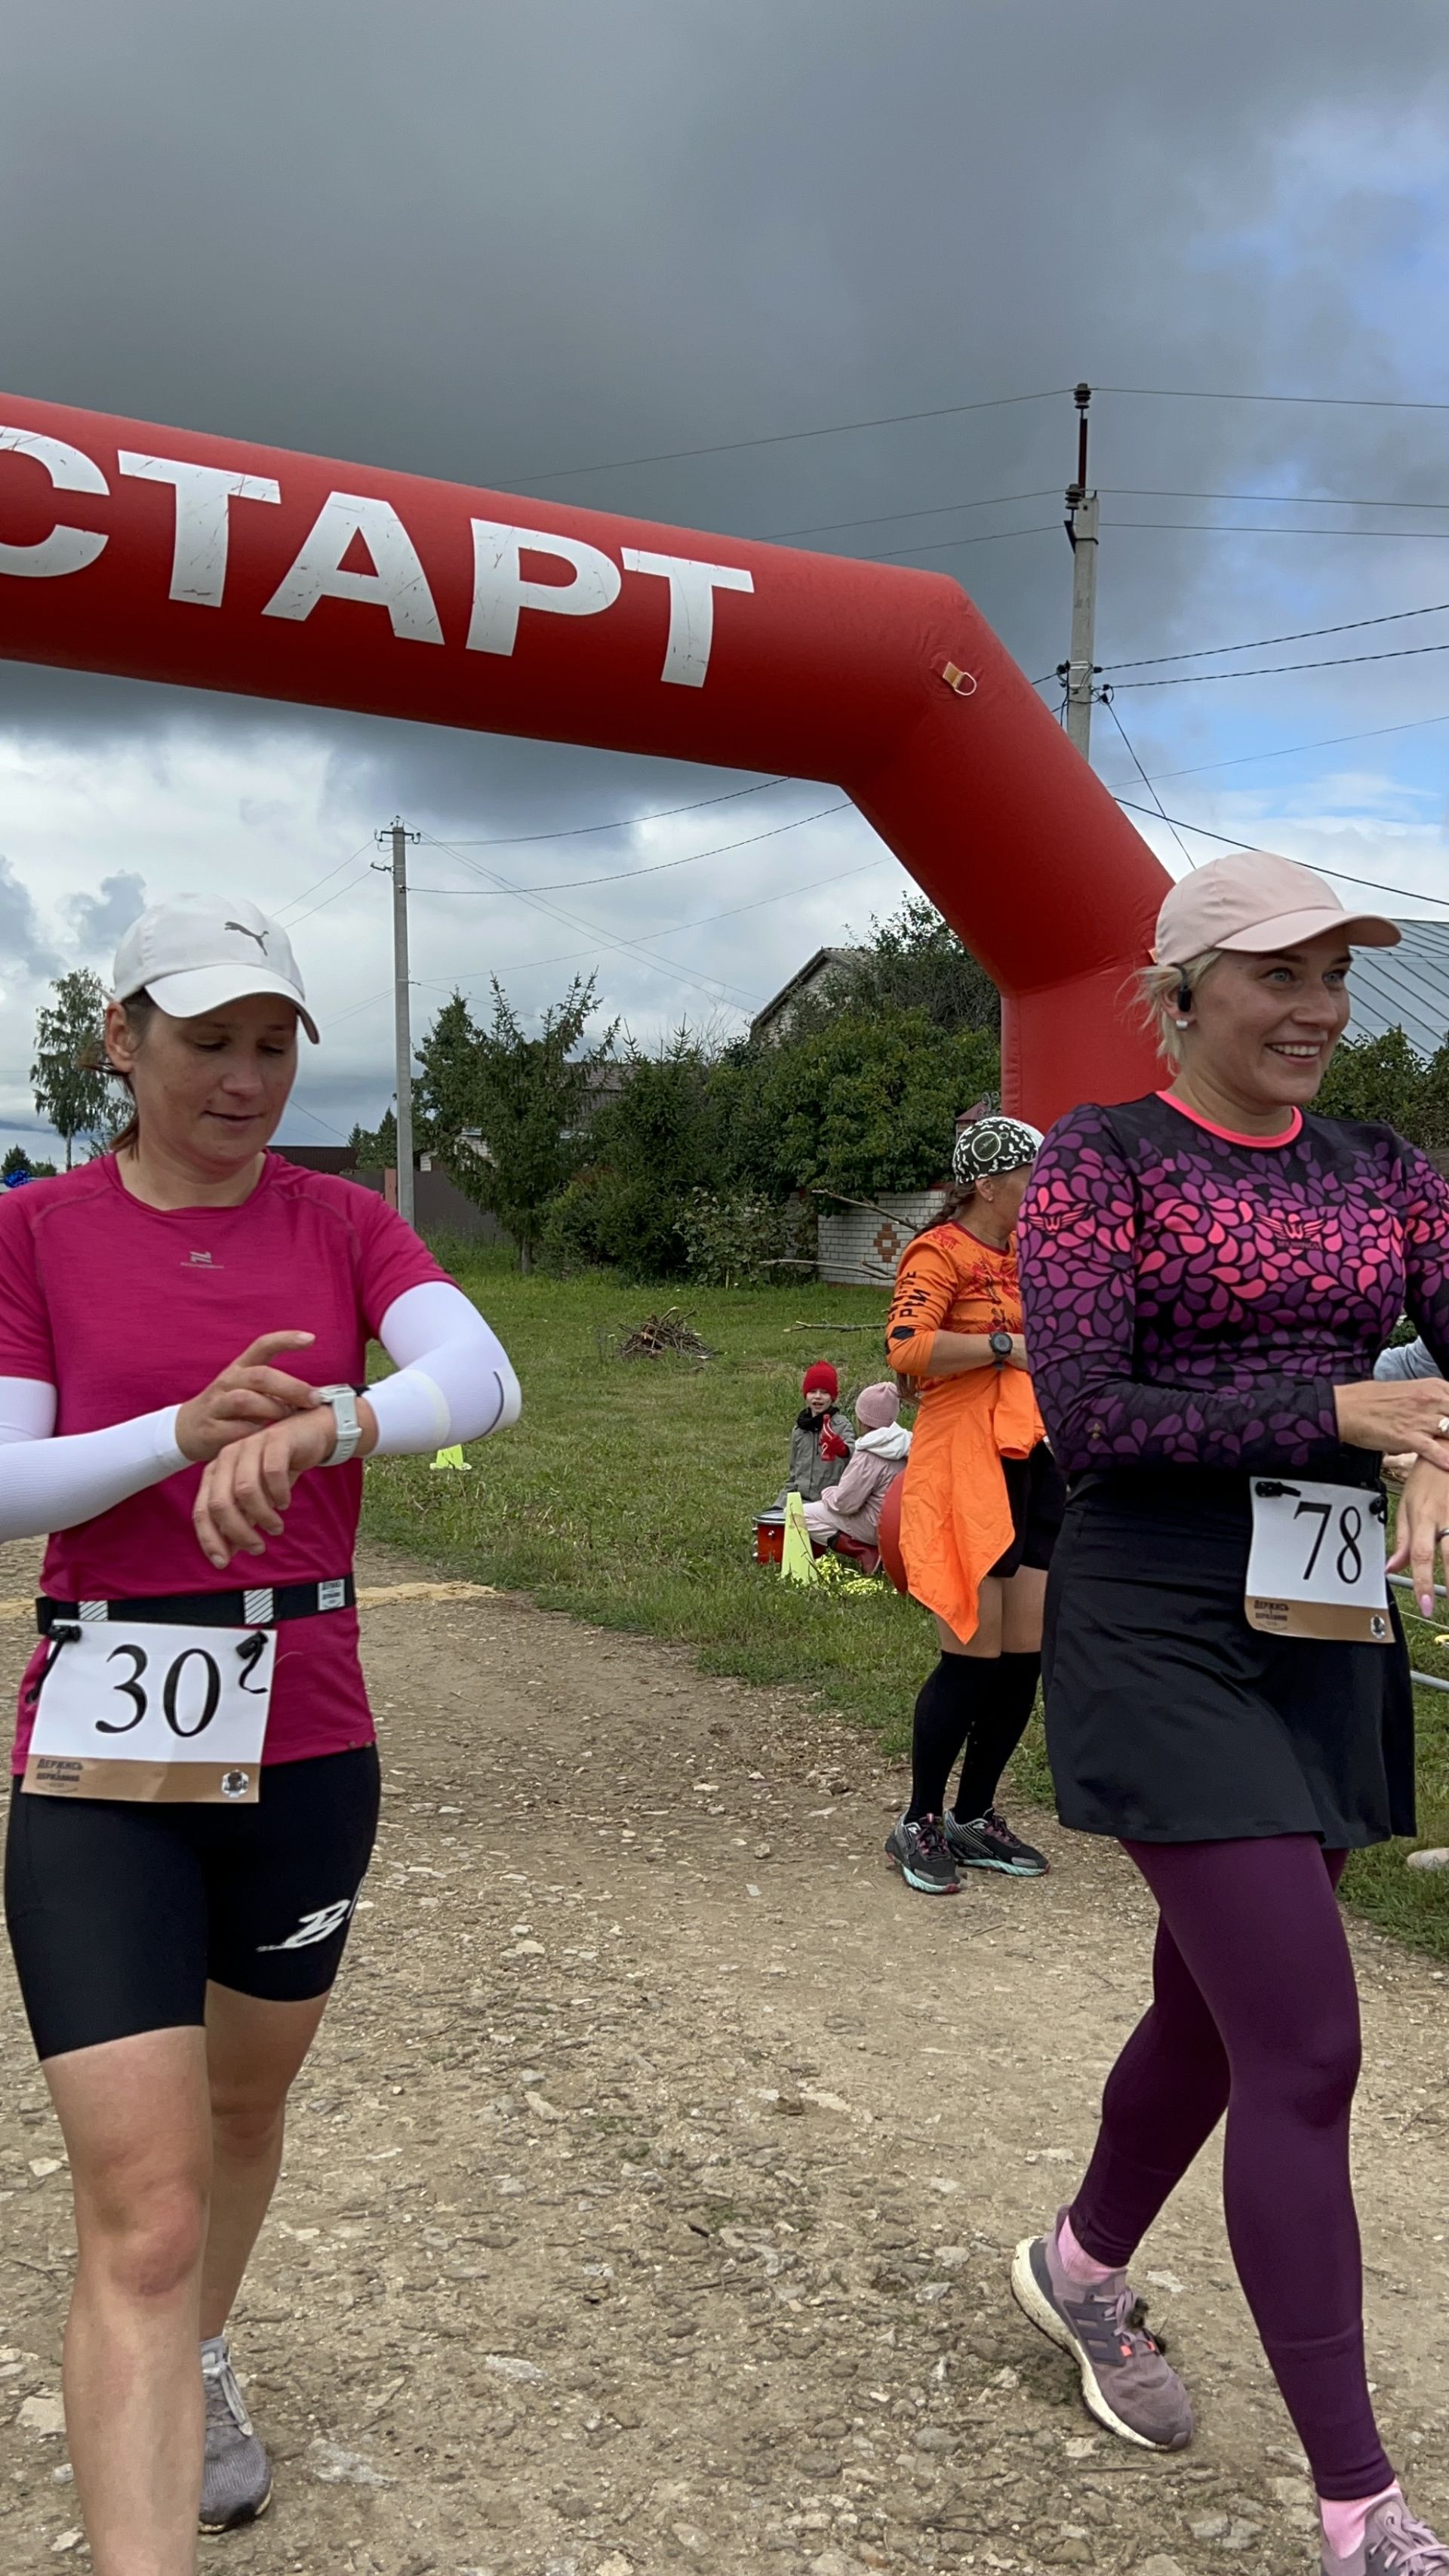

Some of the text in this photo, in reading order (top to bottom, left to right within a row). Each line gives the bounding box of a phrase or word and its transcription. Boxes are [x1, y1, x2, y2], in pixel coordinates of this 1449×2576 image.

[0, 426, 754, 688] СТАРТ
[1294, 1501, 1361, 1583] 78
[95, 1644, 220, 1737] 30
